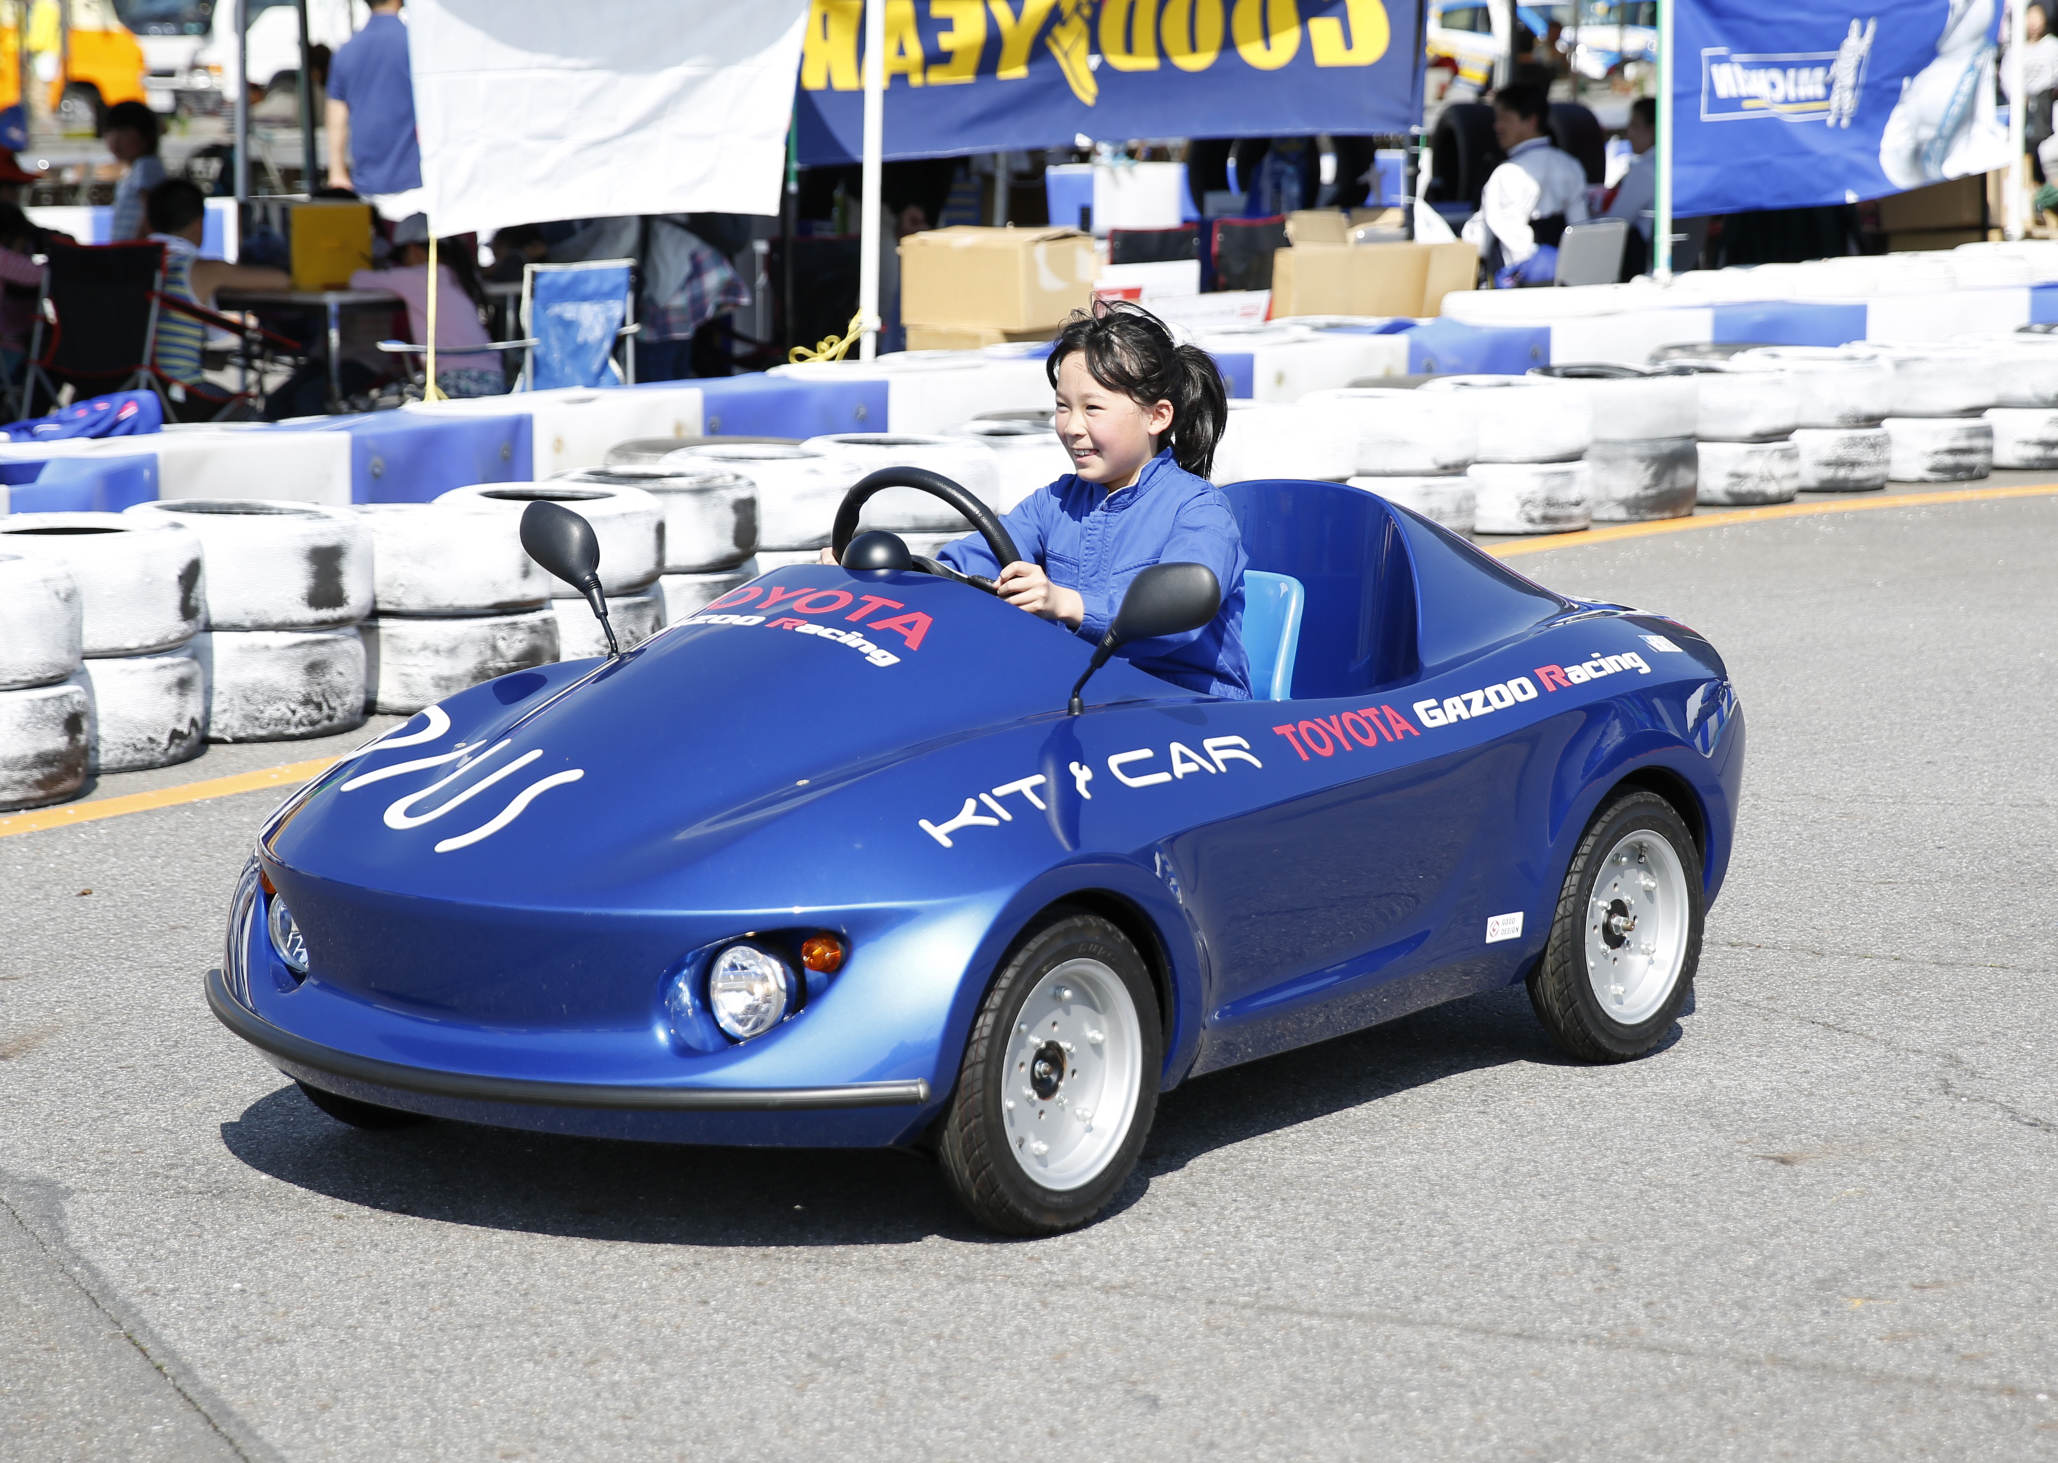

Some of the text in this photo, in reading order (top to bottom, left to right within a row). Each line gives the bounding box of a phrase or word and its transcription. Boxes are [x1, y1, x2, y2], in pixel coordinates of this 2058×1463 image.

[706, 586, 934, 651] OYOTA
[764, 617, 901, 667] Racing
[1272, 652, 1652, 762] TOYOTA GAZOO Racing
[918, 736, 1263, 848] KIT CAR
